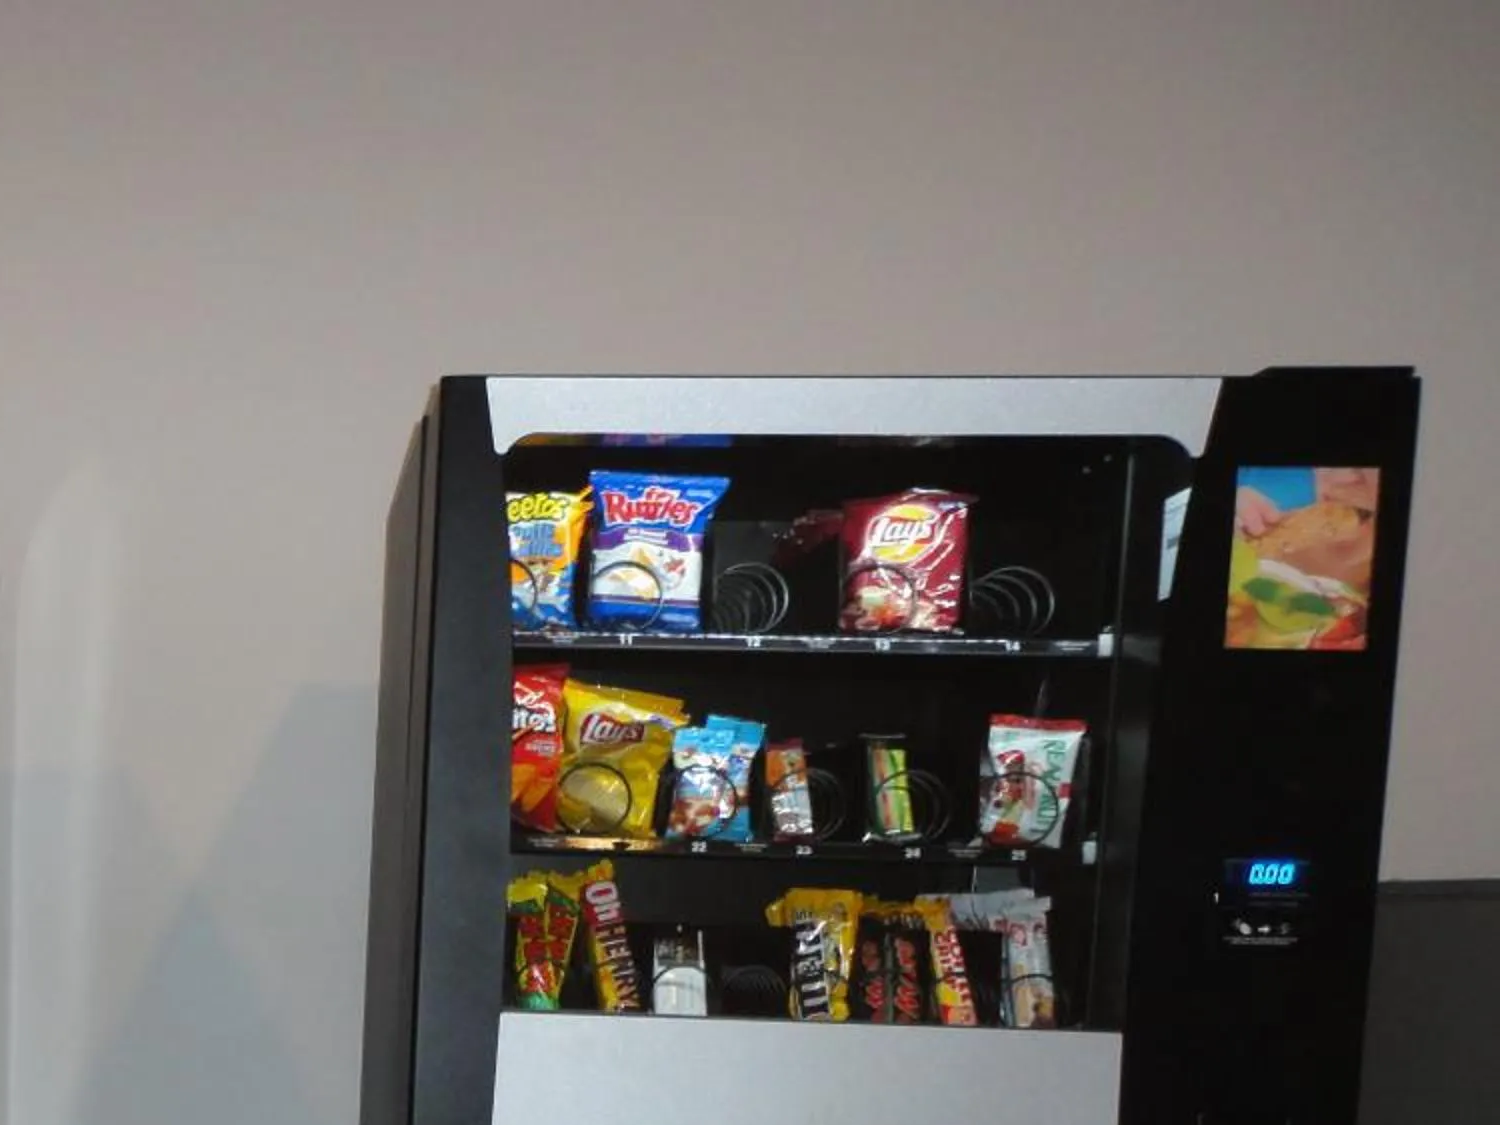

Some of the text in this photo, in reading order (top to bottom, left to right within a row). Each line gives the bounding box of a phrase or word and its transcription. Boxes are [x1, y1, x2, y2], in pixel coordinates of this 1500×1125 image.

[508, 492, 569, 521] eetos
[602, 487, 699, 526] Ruffles
[512, 706, 556, 732] itos
